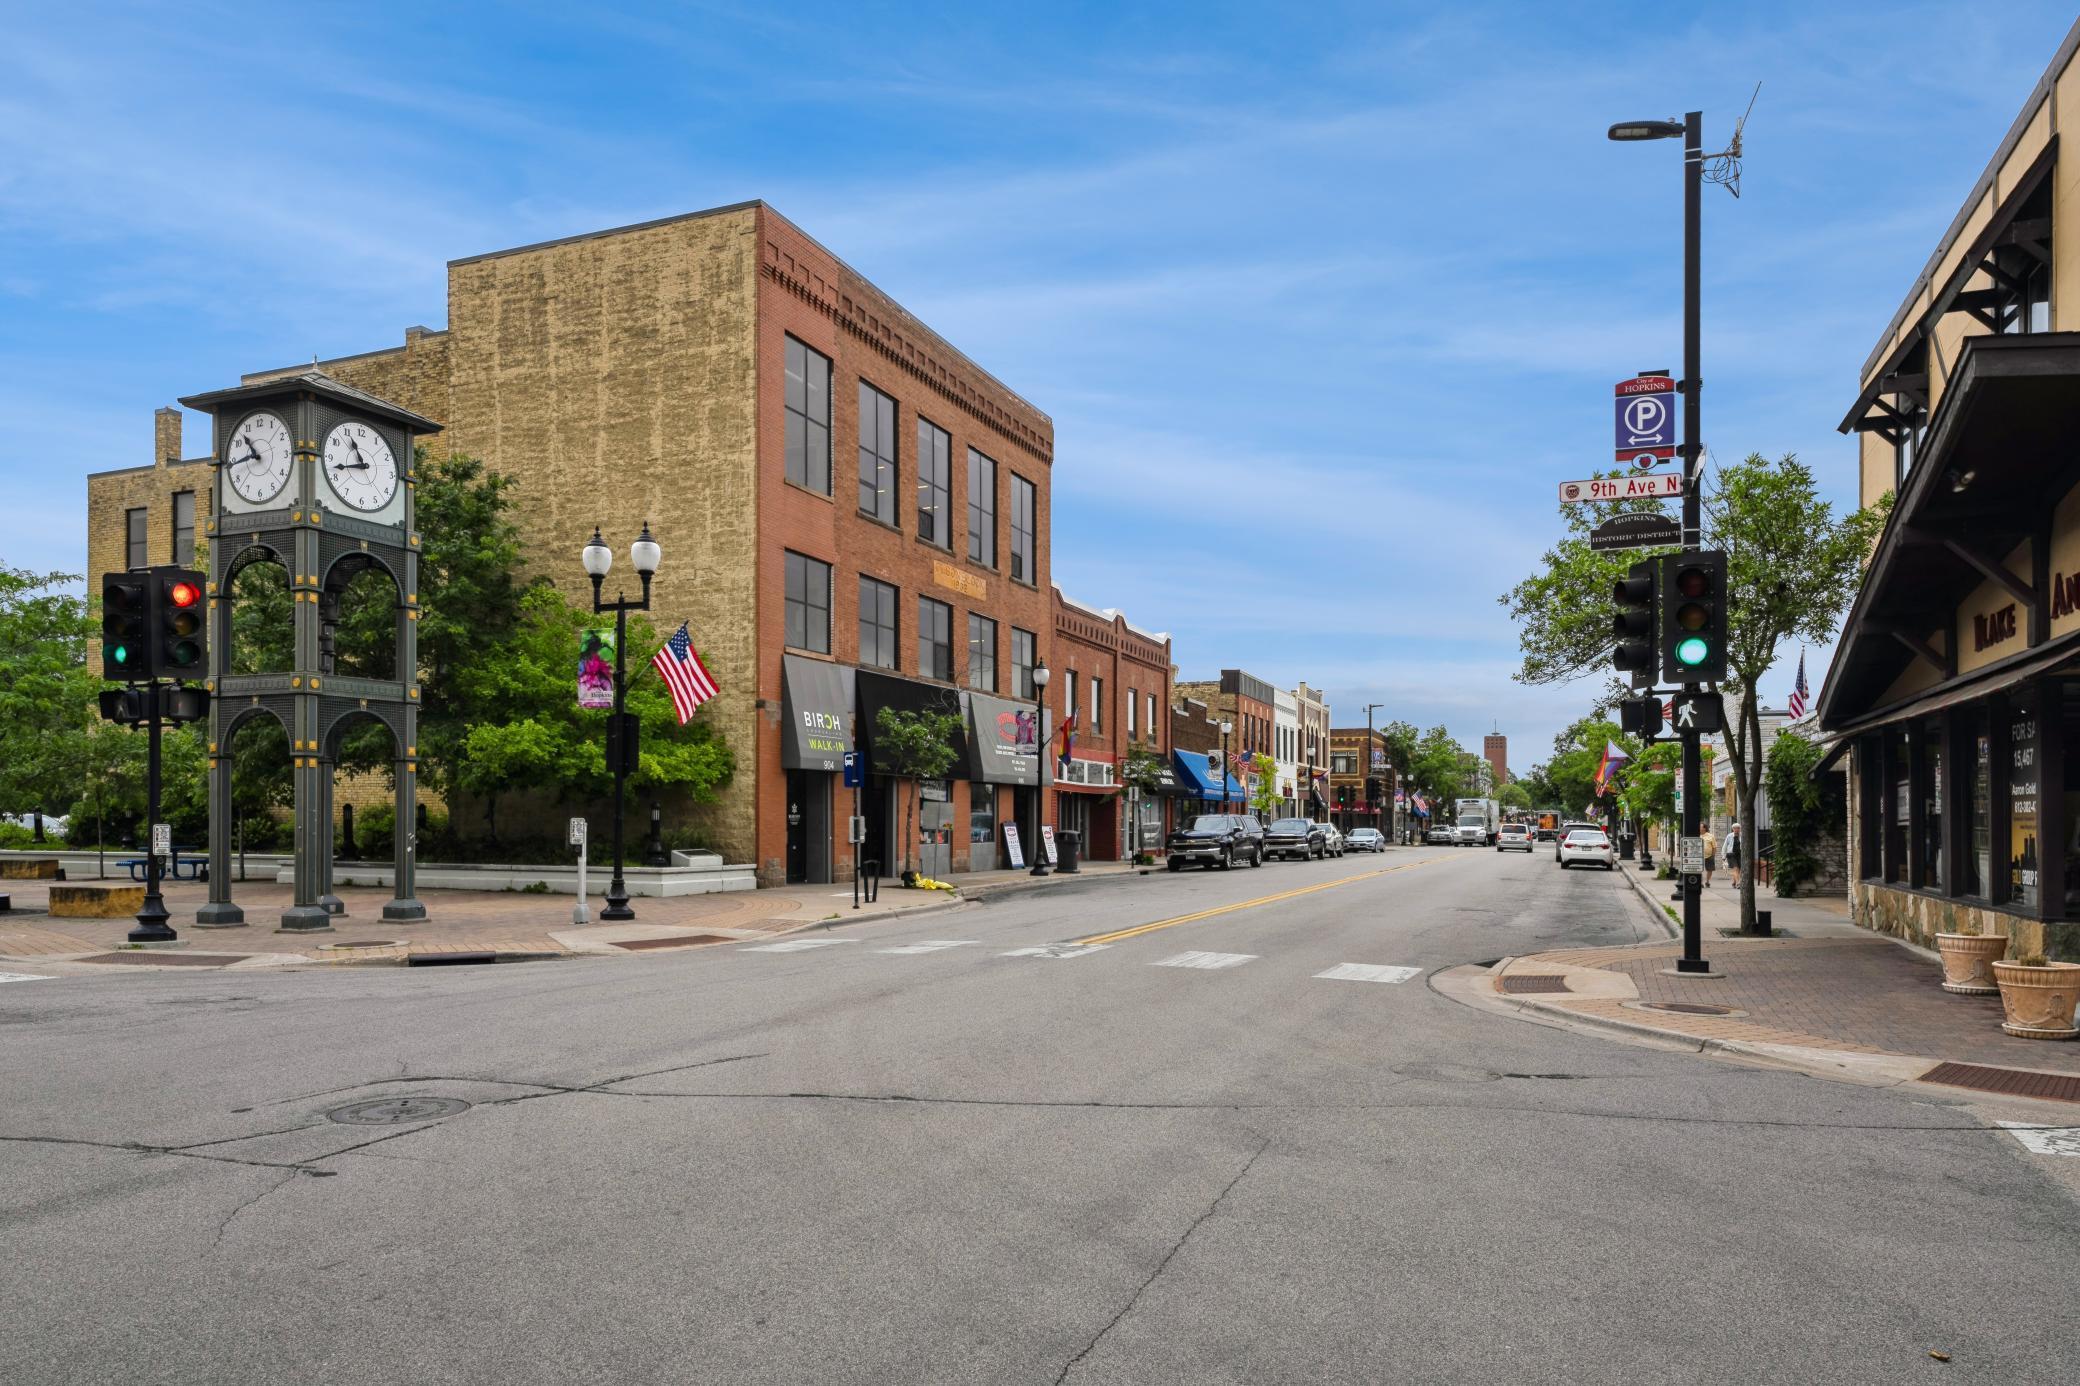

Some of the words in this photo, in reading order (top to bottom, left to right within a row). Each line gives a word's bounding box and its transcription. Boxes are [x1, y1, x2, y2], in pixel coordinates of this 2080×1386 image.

[1625, 382, 1665, 392] HOPKINS
[1637, 402, 1656, 430] P
[1591, 482, 1616, 497] 9th
[1627, 480, 1656, 494] Ave
[1667, 476, 1676, 491] N
[1614, 515, 1656, 525] HOPKINS
[1592, 534, 1634, 543] HISTORIC
[1638, 531, 1681, 539] DISTRICT
[1974, 603, 2015, 652] BLAKE
[804, 711, 840, 730] BIRCH
[2012, 722, 2026, 741] FOR
[809, 739, 844, 751] WALK-IN
[824, 760, 834, 770] 904
[2012, 784, 2024, 796] Aaron
